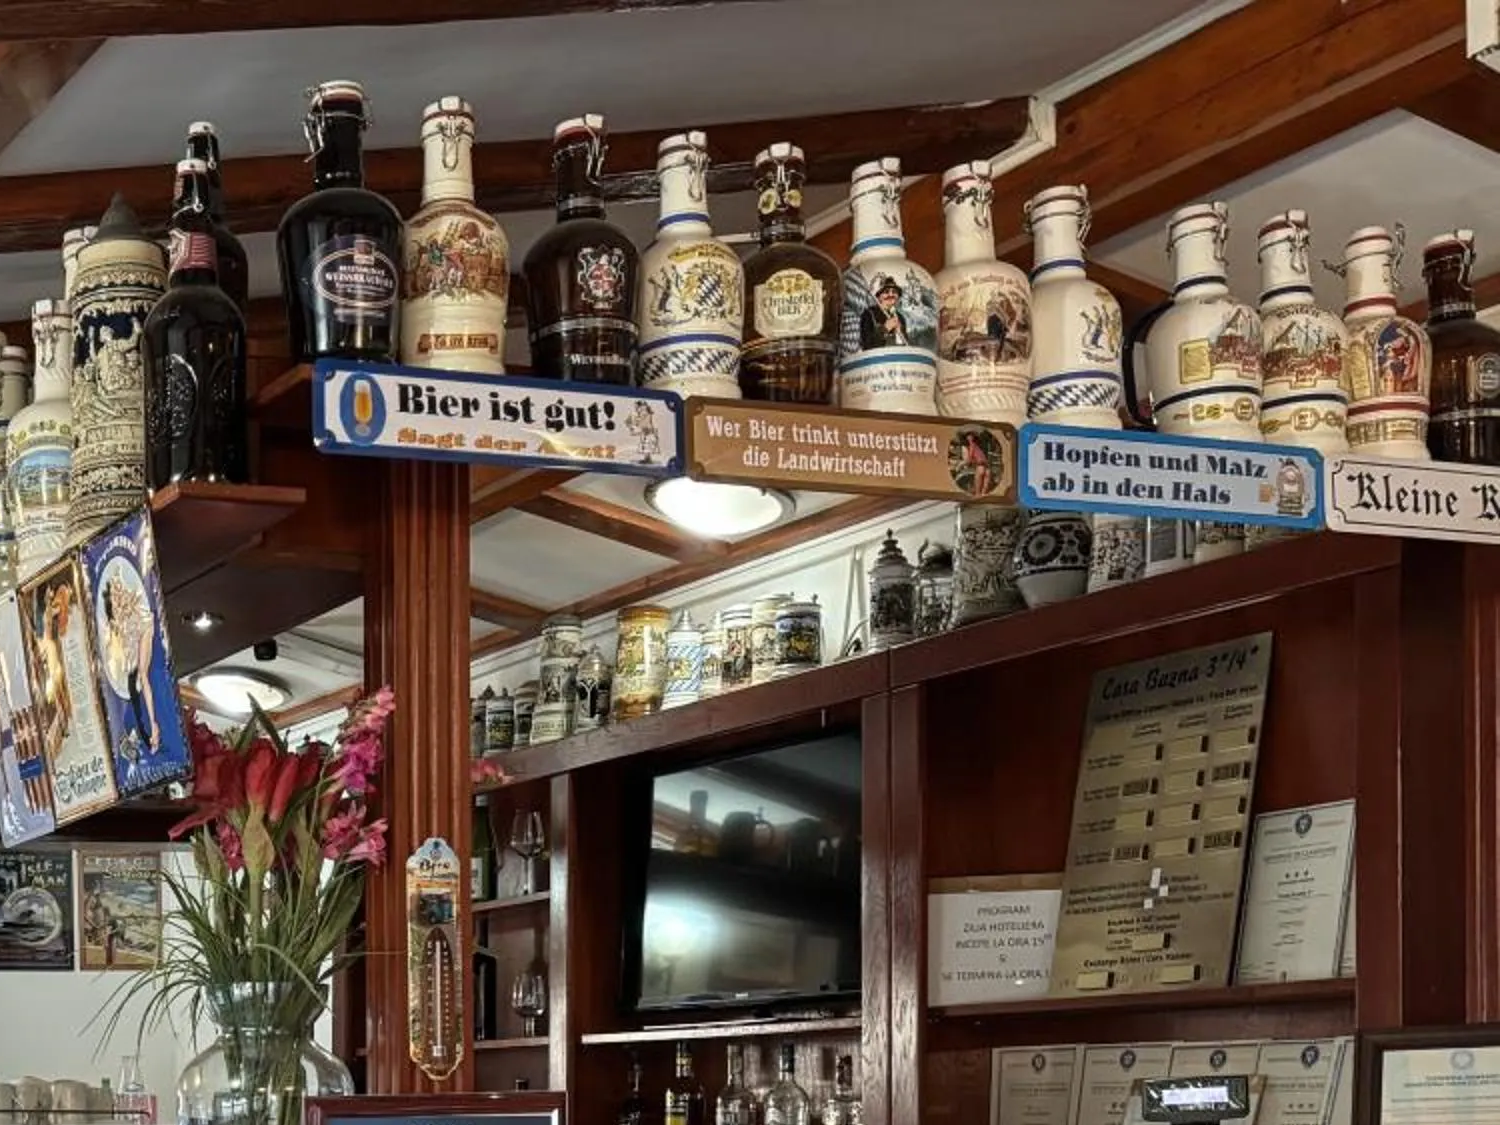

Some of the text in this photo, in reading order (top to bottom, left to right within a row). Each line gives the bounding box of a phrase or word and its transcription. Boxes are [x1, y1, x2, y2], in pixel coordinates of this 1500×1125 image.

[396, 382, 616, 433] Bier ist gut!
[474, 435, 528, 453] der
[705, 415, 938, 454] Wer Bier trinkt unterstützt
[743, 445, 906, 477] die Landwirtschaft
[1043, 441, 1269, 478] Hopfen und Malz
[1041, 472, 1233, 505] ab in den Hals
[1346, 471, 1460, 517] Kleine
[1102, 677, 1140, 701] Casa
